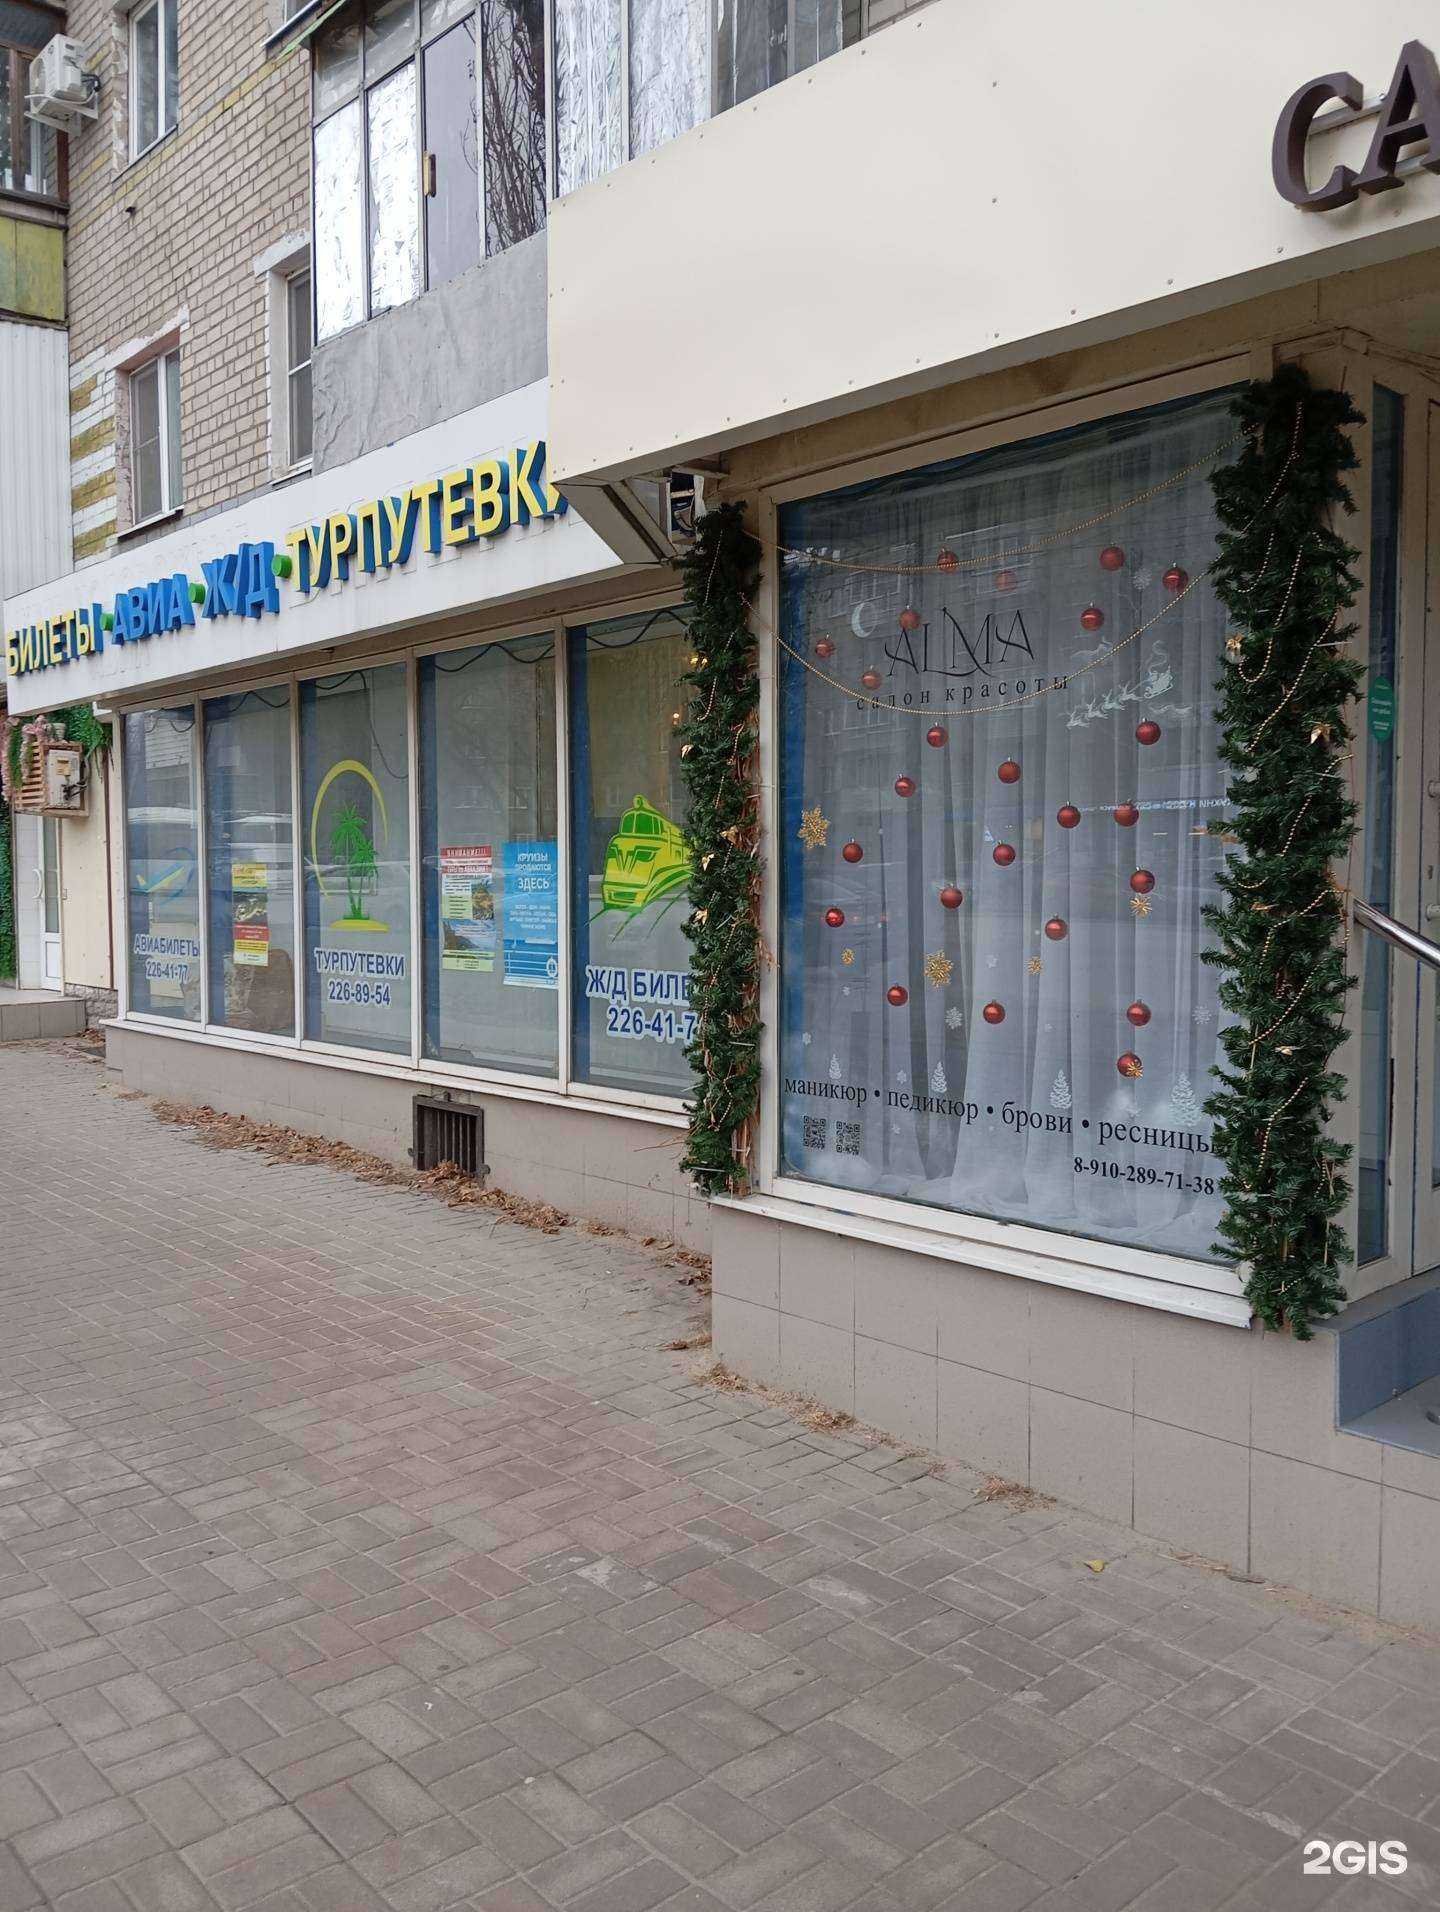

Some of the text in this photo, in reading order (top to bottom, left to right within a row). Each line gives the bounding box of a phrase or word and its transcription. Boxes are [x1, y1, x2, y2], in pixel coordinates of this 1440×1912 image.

[6, 602, 104, 676] БИЛЕТЫ
[112, 573, 196, 645] АВИА
[201, 541, 280, 619] Ж/Д
[884, 606, 1035, 677] ALMA
[856, 676, 1069, 711] салон красоты
[517, 877, 550, 892] ЗДЕСЬ
[146, 960, 189, 981] 226-41-77
[315, 949, 405, 977] ТУРПУТЕВКИ
[328, 980, 391, 1006] 226-89-54
[588, 968, 627, 1001] Ж/Д
[784, 1077, 868, 1108] маникюр
[887, 1090, 979, 1125] педикюр
[1001, 1101, 1073, 1134] брови
[1073, 1156, 1215, 1196] 8-910-289-71-38
